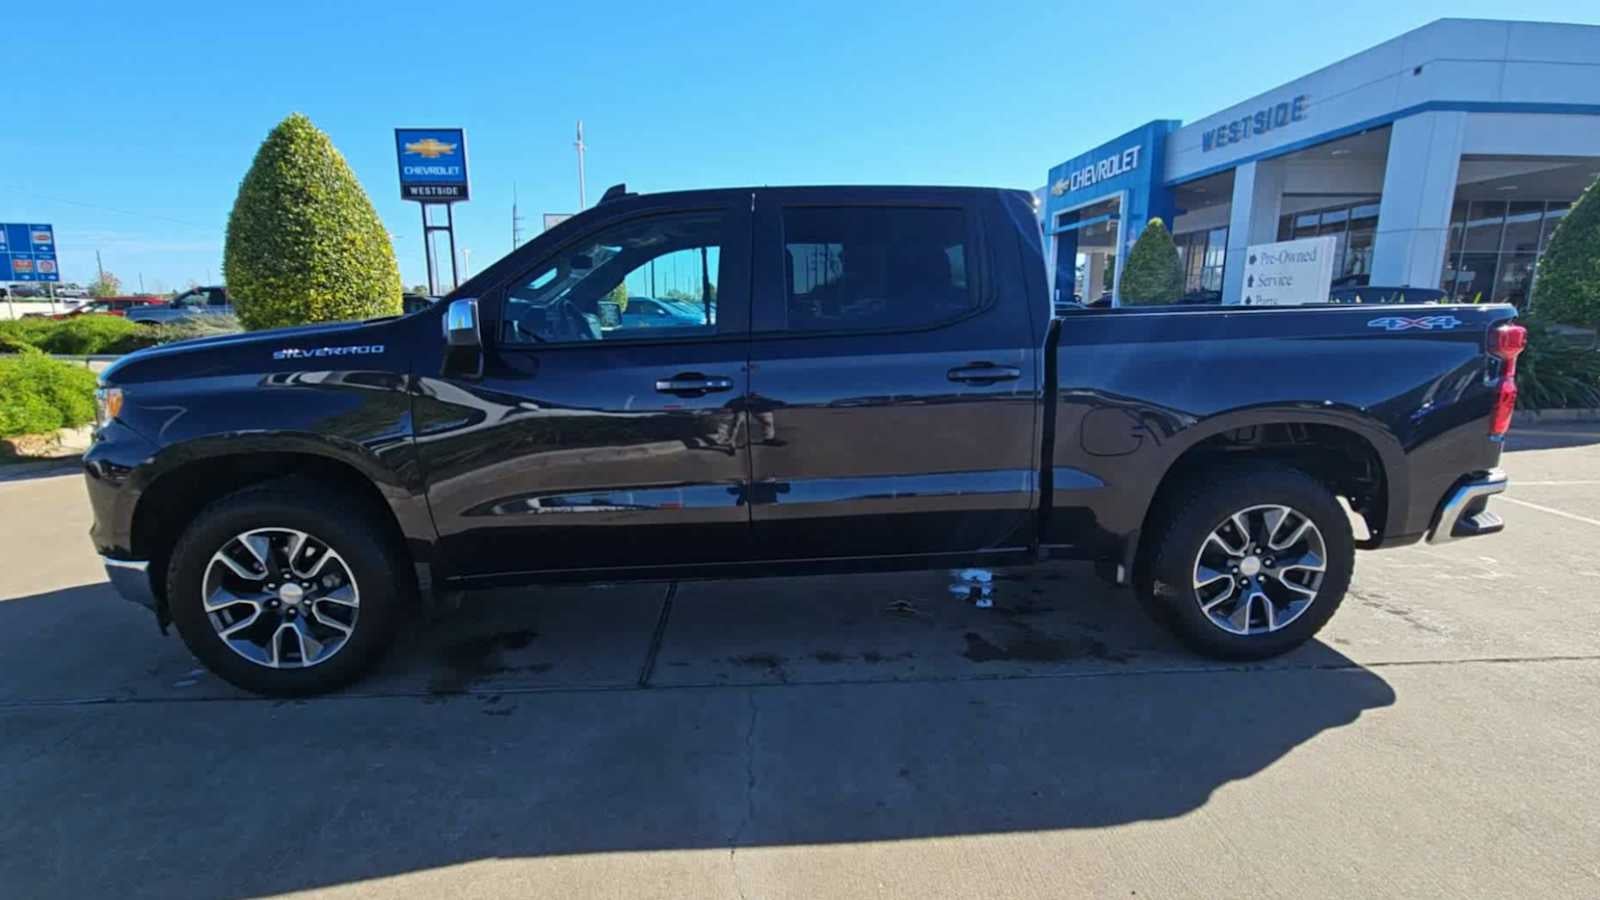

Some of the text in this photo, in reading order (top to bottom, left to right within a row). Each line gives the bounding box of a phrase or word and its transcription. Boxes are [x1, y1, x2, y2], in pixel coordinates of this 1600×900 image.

[1202, 95, 1310, 153] WESTSIDE
[403, 165, 460, 176] CHEVROLET
[1070, 144, 1142, 192] CHEVROLET
[409, 186, 459, 196] WESTSIDE
[1261, 247, 1317, 265] Pre-Owned
[1258, 273, 1293, 288] Service
[273, 345, 385, 360] SILVERADO
